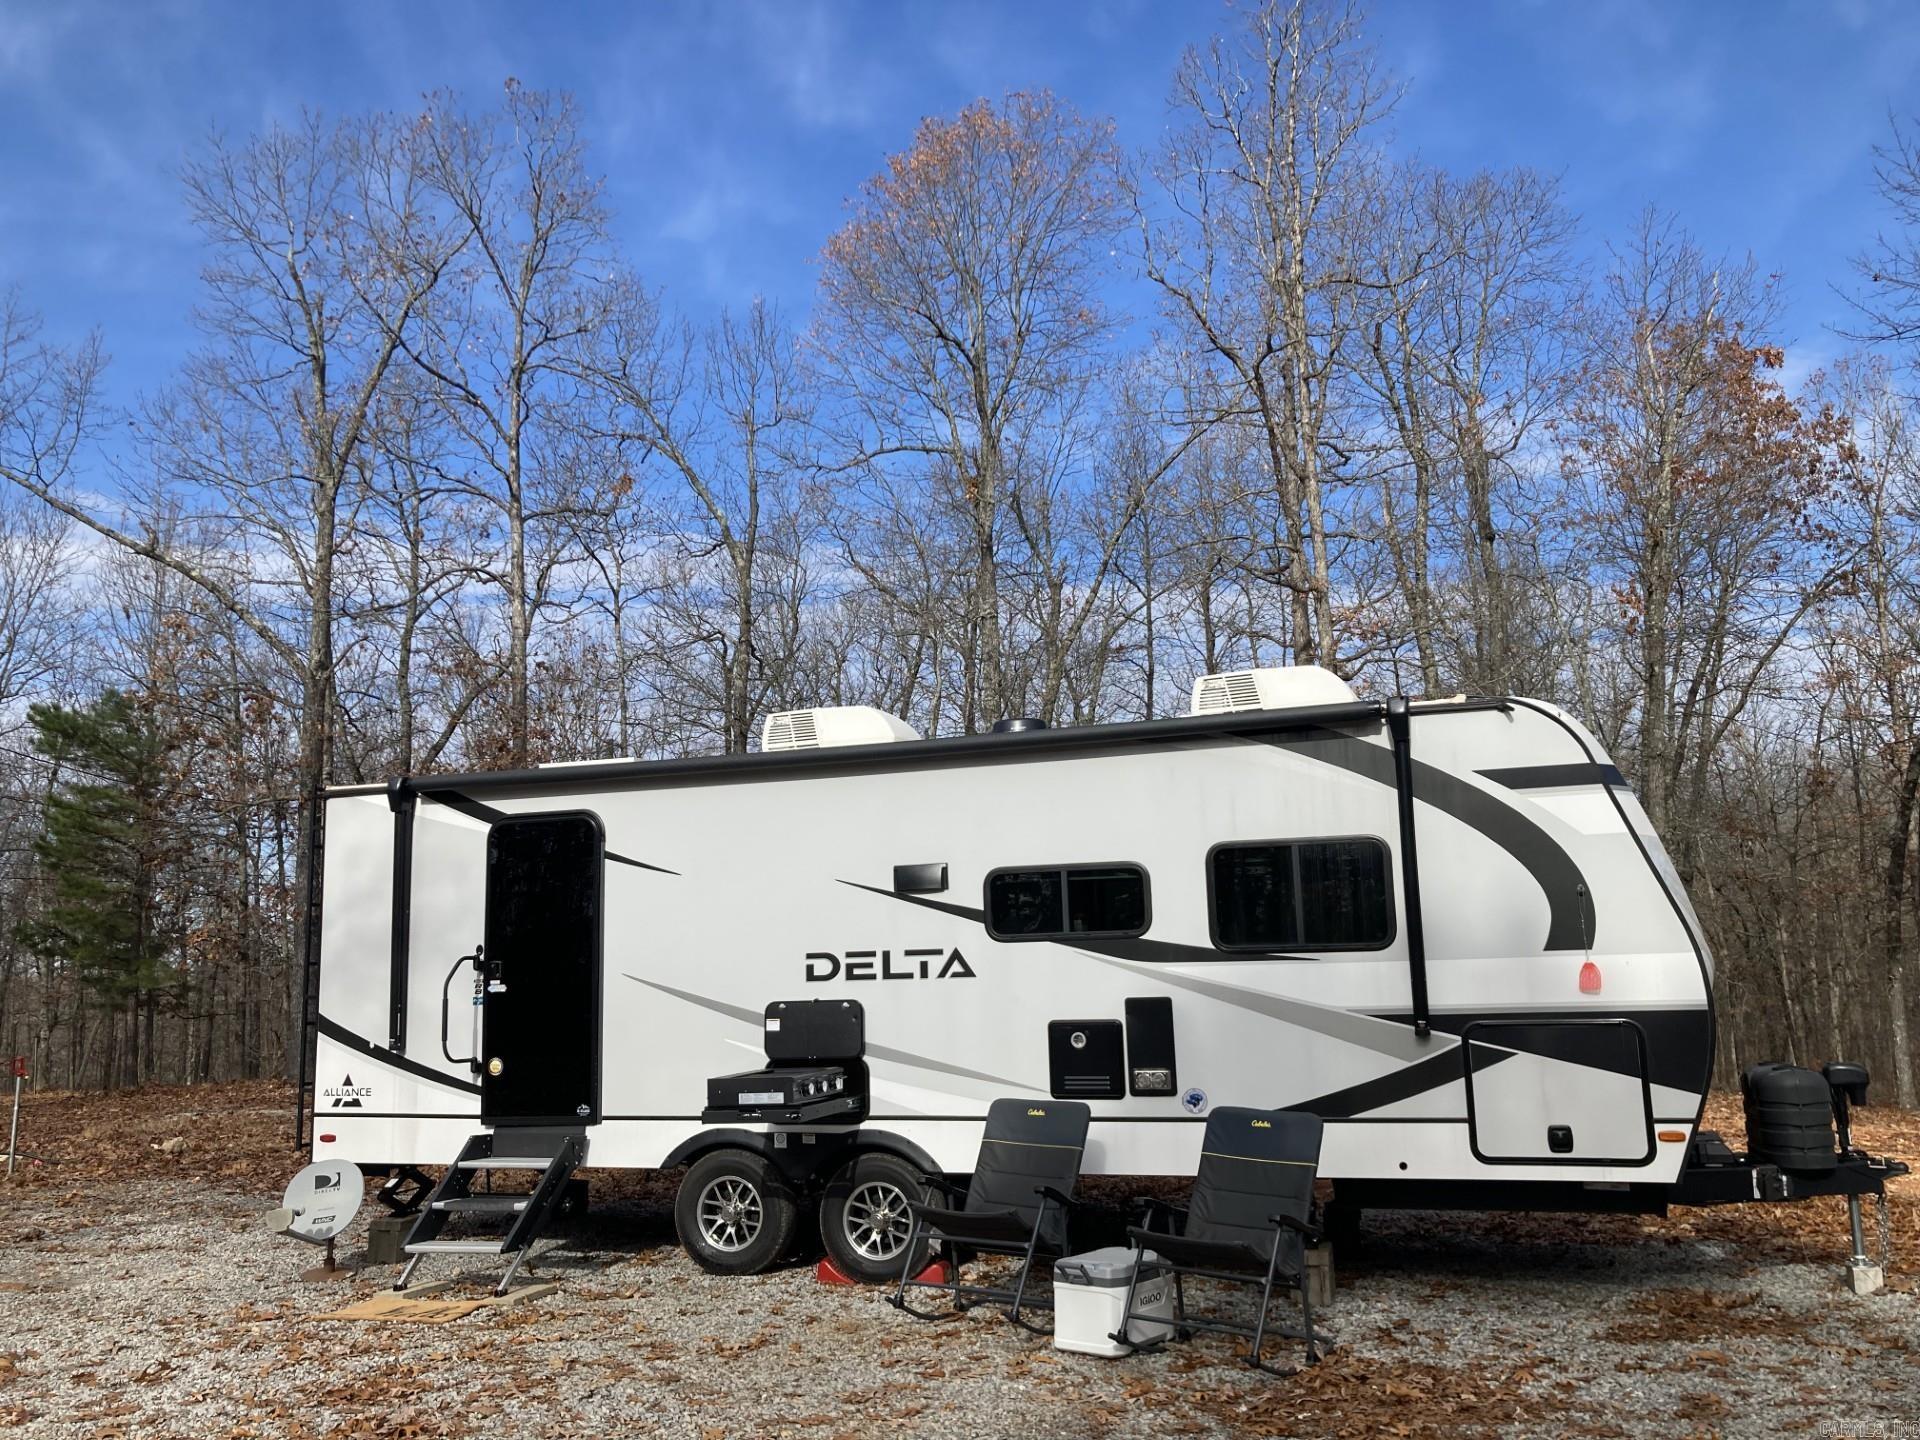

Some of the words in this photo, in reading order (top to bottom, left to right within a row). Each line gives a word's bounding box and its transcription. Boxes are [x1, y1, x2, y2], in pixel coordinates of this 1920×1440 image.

[805, 946, 977, 982] DELTA
[323, 1087, 372, 1097] ALLIANCE
[1139, 1292, 1162, 1306] IGLOO
